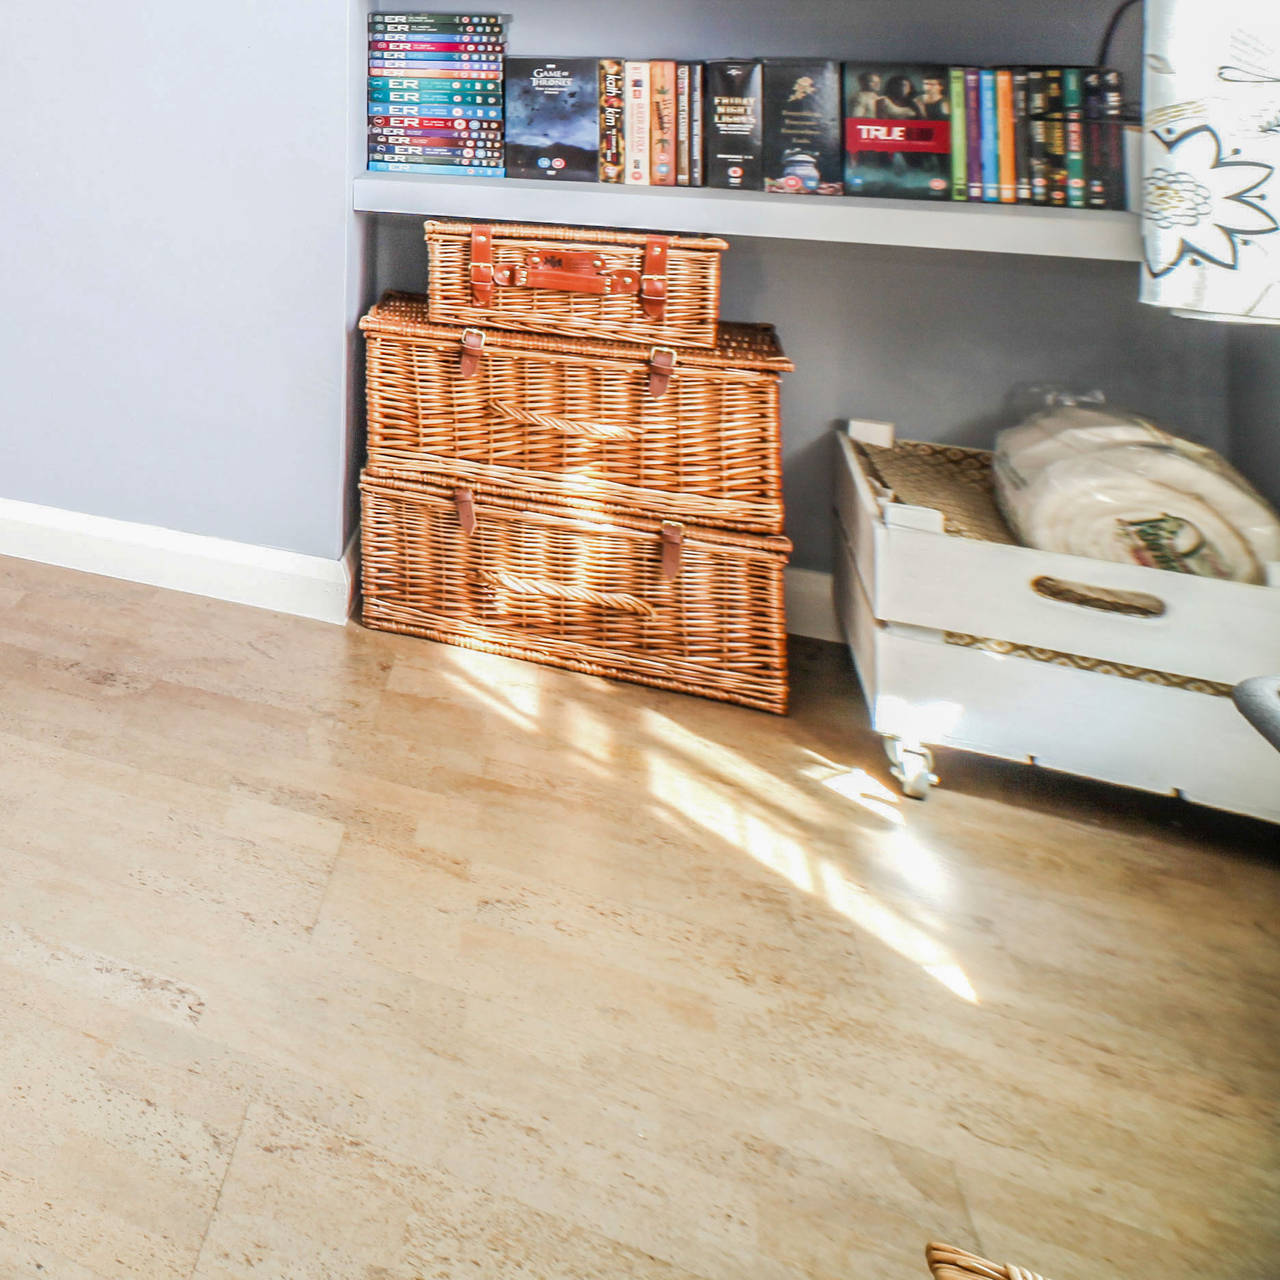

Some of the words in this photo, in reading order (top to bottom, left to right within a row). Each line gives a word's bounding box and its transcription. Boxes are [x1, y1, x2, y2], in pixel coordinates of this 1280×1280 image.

[384, 15, 407, 23] ER
[387, 24, 410, 32] ER
[384, 33, 407, 41] ER
[383, 51, 405, 59] ER
[533, 68, 561, 78] GAME
[388, 79, 419, 90] ER
[531, 77, 572, 87] THRONES
[605, 74, 622, 96] kath
[389, 91, 420, 103] ER
[713, 96, 756, 106] FRIDAY
[389, 105, 419, 116] ER
[716, 105, 752, 115] NIGHT
[605, 107, 622, 126] kim
[713, 114, 756, 124] LIGHTS
[389, 117, 419, 128] ER
[382, 127, 405, 136] ER
[856, 125, 906, 141] TRUE
[388, 136, 410, 145] ER
[394, 145, 423, 156] ER
[384, 154, 406, 162] ER
